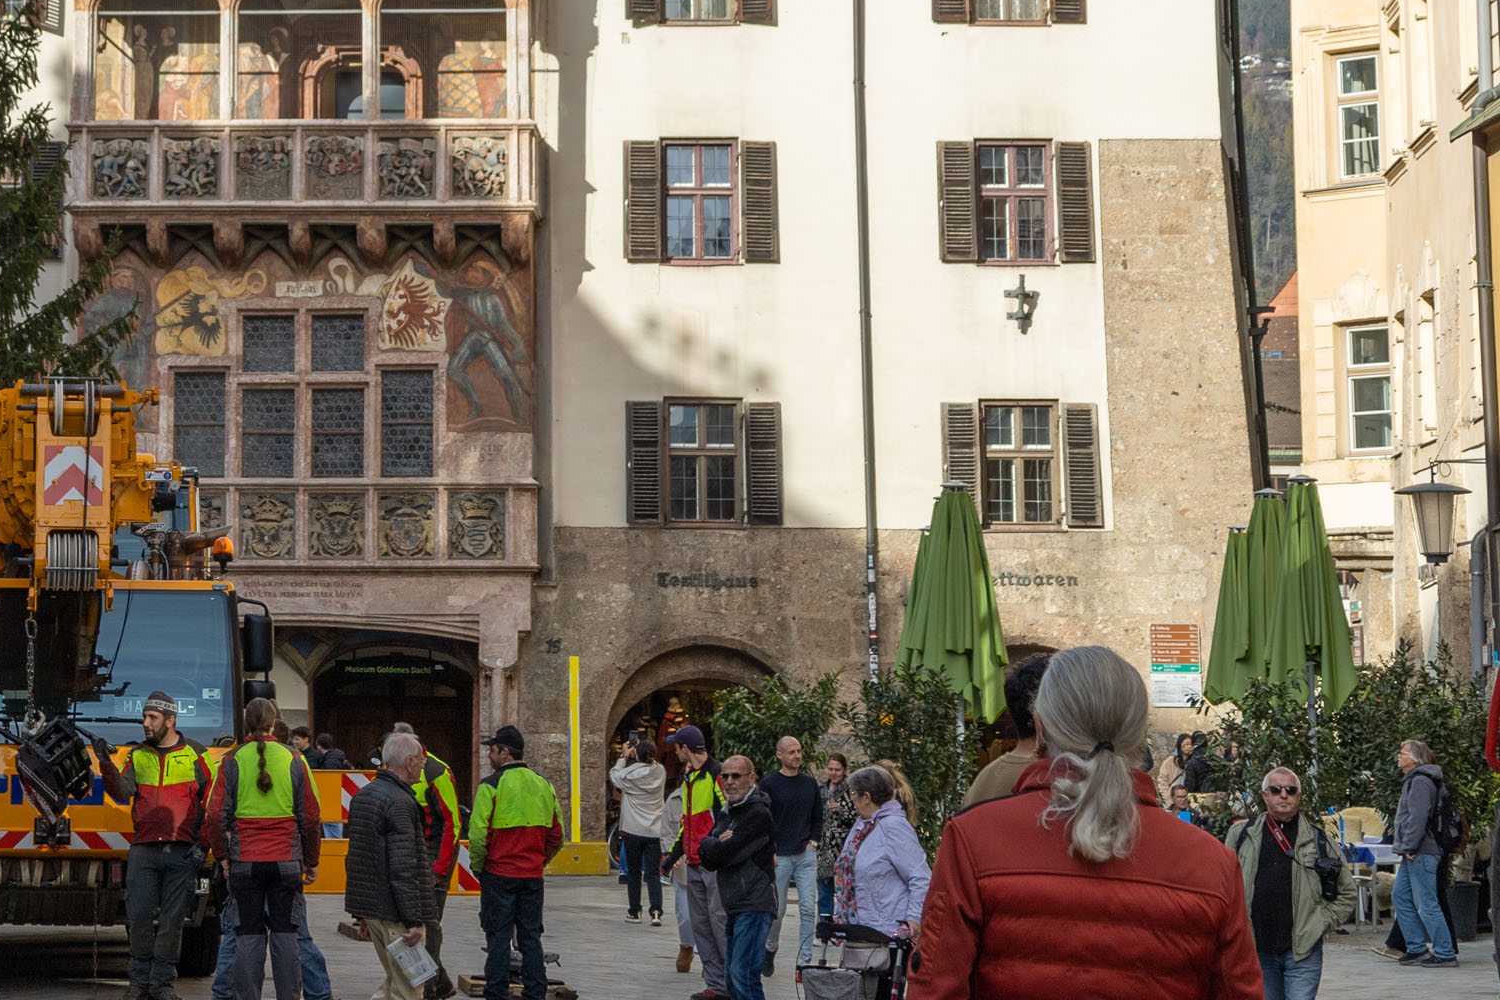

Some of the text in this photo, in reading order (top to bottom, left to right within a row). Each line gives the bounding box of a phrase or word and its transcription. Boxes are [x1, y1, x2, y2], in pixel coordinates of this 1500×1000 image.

[991, 571, 1079, 587] ettwaren
[345, 665, 375, 673] Museum
[377, 666, 409, 674] Goldenes
